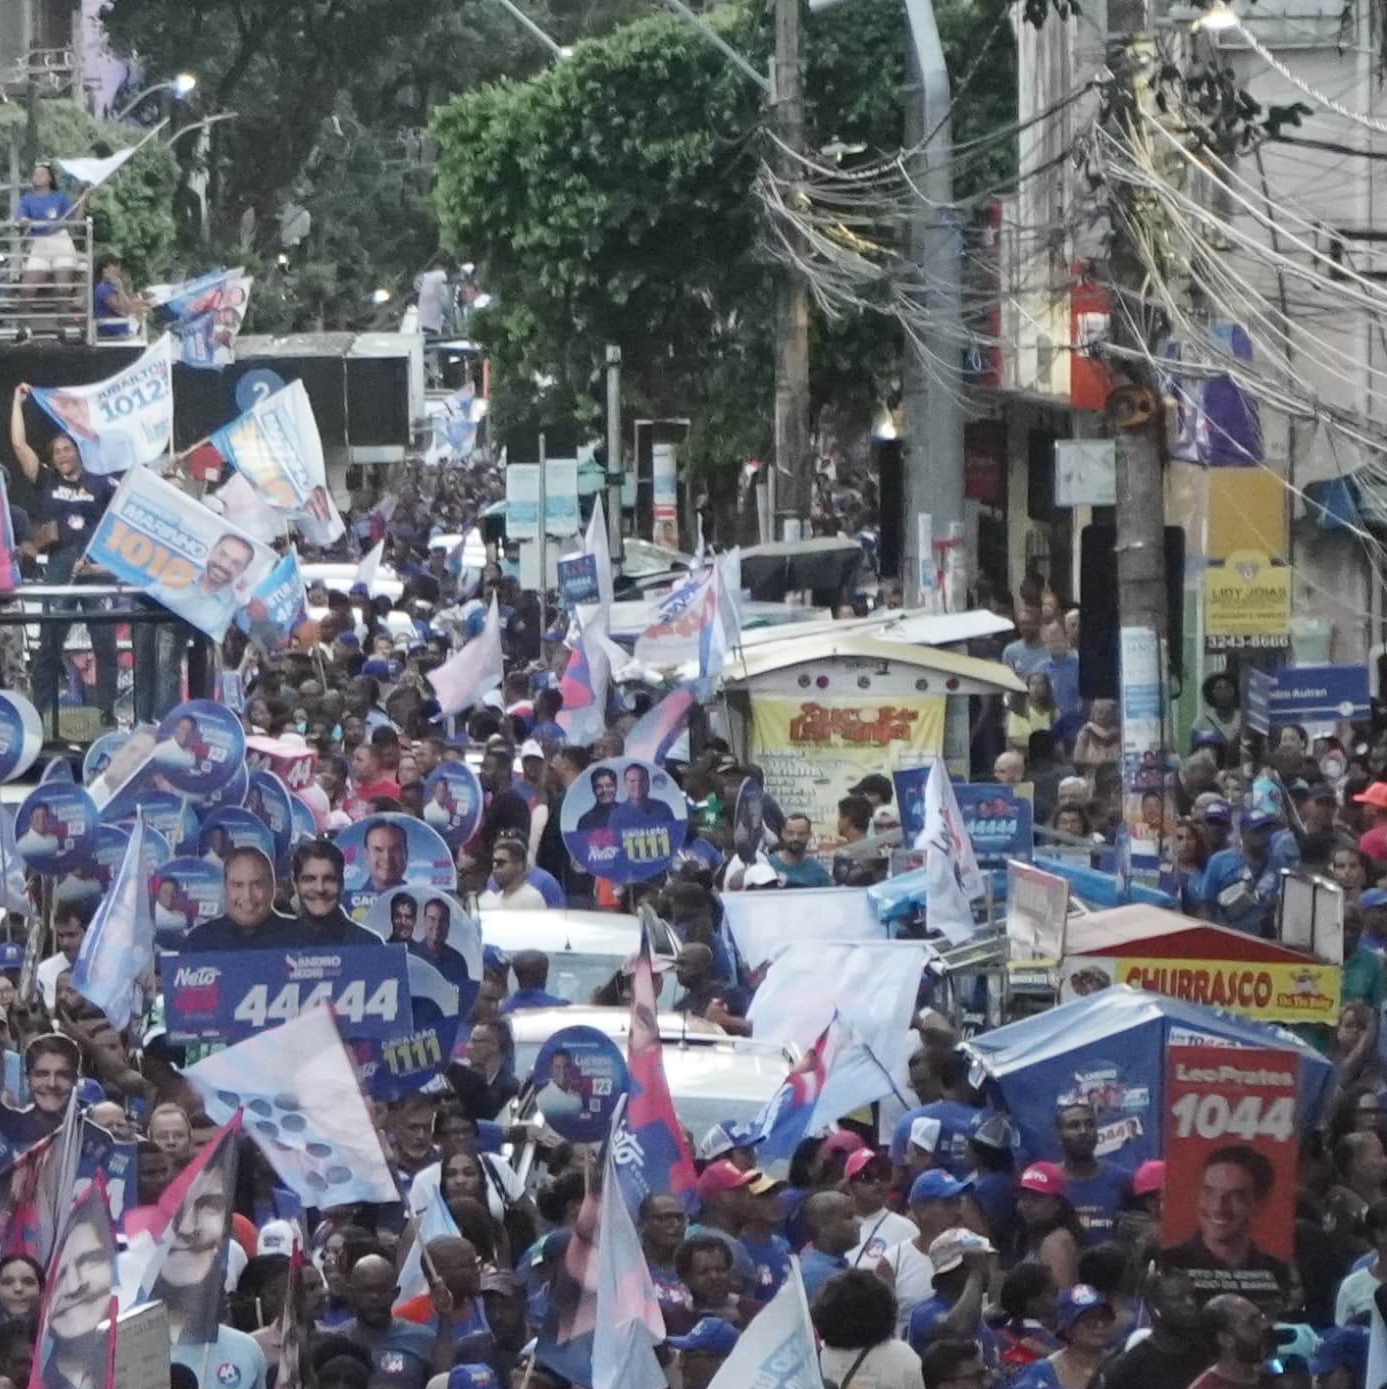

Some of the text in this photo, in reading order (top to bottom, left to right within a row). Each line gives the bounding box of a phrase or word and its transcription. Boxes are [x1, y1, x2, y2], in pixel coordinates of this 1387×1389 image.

[174, 965, 221, 988] Neto
[1126, 966, 1274, 1008] CHURRASCO
[1171, 1093, 1296, 1143] 1044
